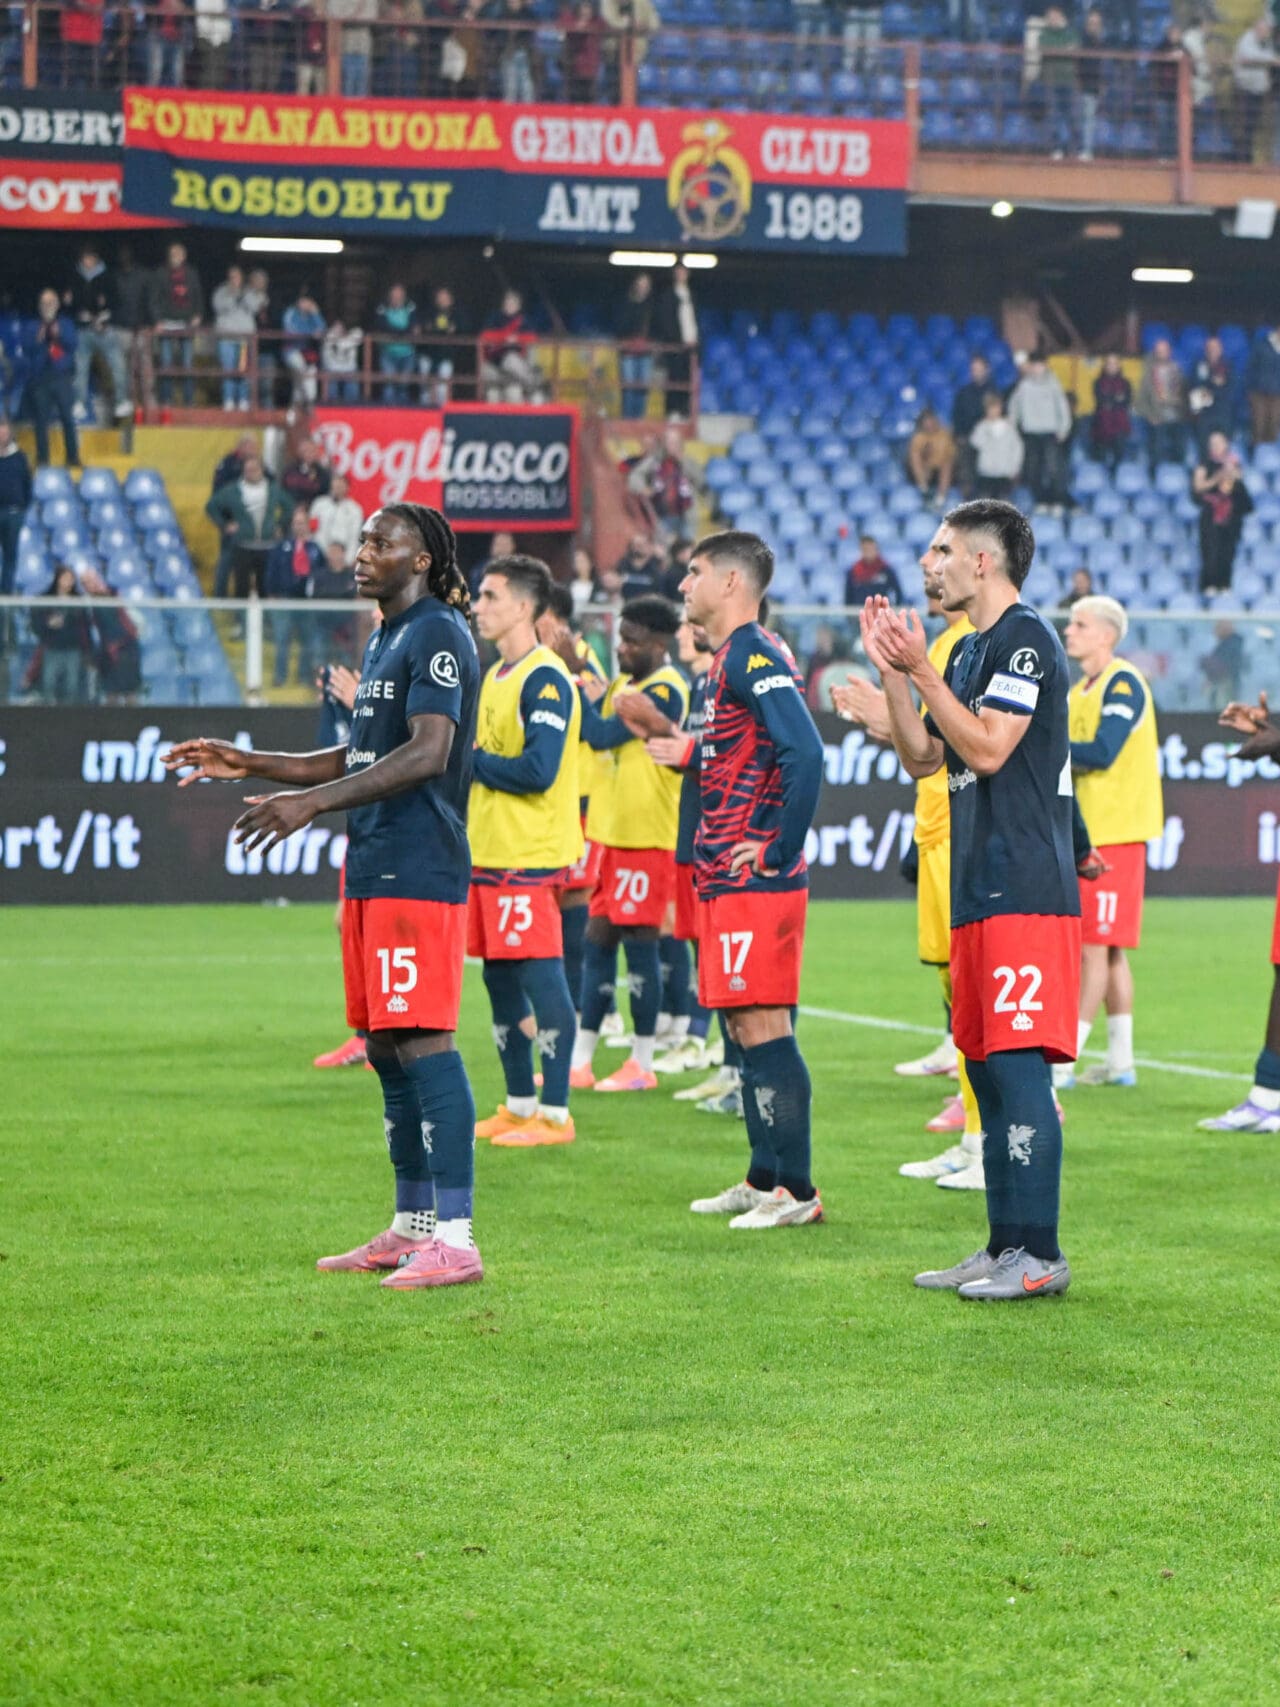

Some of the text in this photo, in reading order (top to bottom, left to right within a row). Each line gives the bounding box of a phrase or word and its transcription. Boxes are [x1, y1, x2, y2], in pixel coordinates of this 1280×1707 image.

[512, 116, 871, 176] GENOA CLUB
[171, 169, 452, 221] ROSSOBLU
[539, 182, 640, 232] AMT
[764, 192, 863, 241] 1988
[313, 421, 569, 504] Bogliasco
[614, 868, 649, 902] 70
[1096, 890, 1118, 924] 11
[498, 895, 533, 932] 73
[377, 946, 418, 994] 15
[719, 931, 754, 975] 17
[993, 965, 1043, 1014] 22
